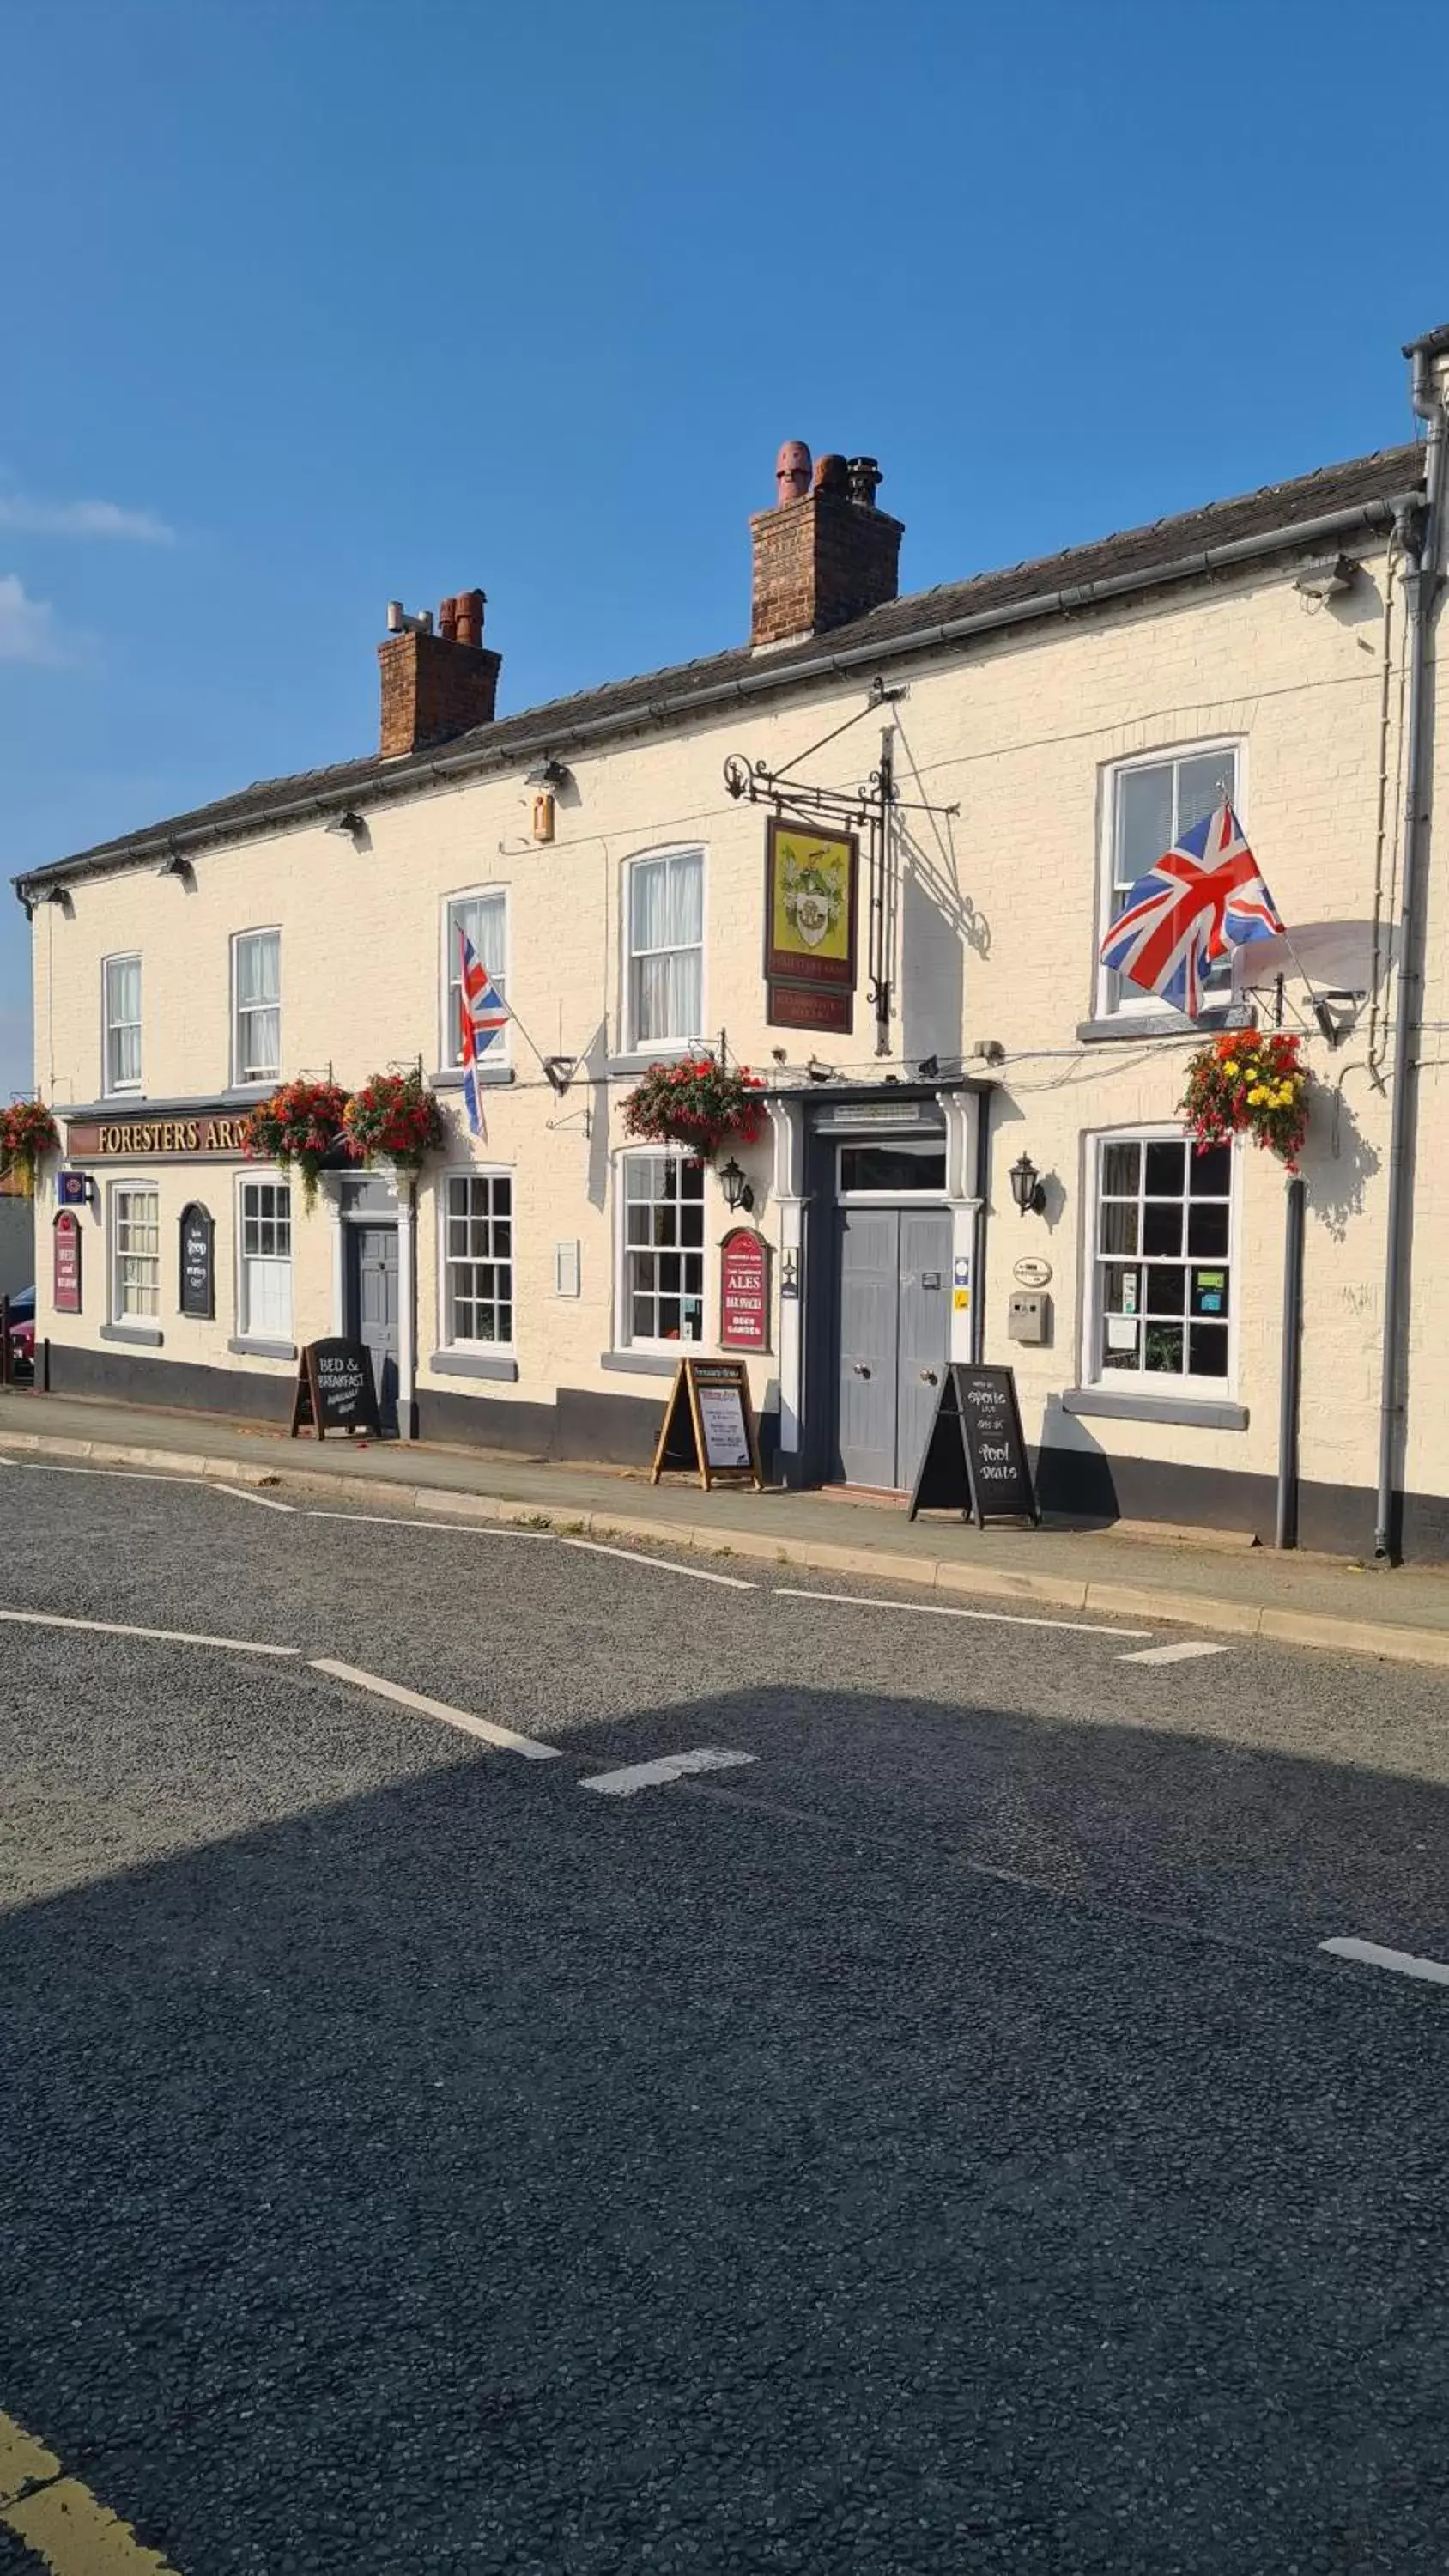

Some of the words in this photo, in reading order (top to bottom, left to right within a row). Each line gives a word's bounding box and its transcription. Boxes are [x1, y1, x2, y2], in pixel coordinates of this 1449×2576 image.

[98, 1121, 198, 1152] FORESTERS
[205, 1121, 247, 1149] ARM
[728, 1275, 761, 1289] ALES
[319, 1358, 344, 1372] BED
[346, 1358, 361, 1371] &
[979, 1442, 1010, 1461] Pool
